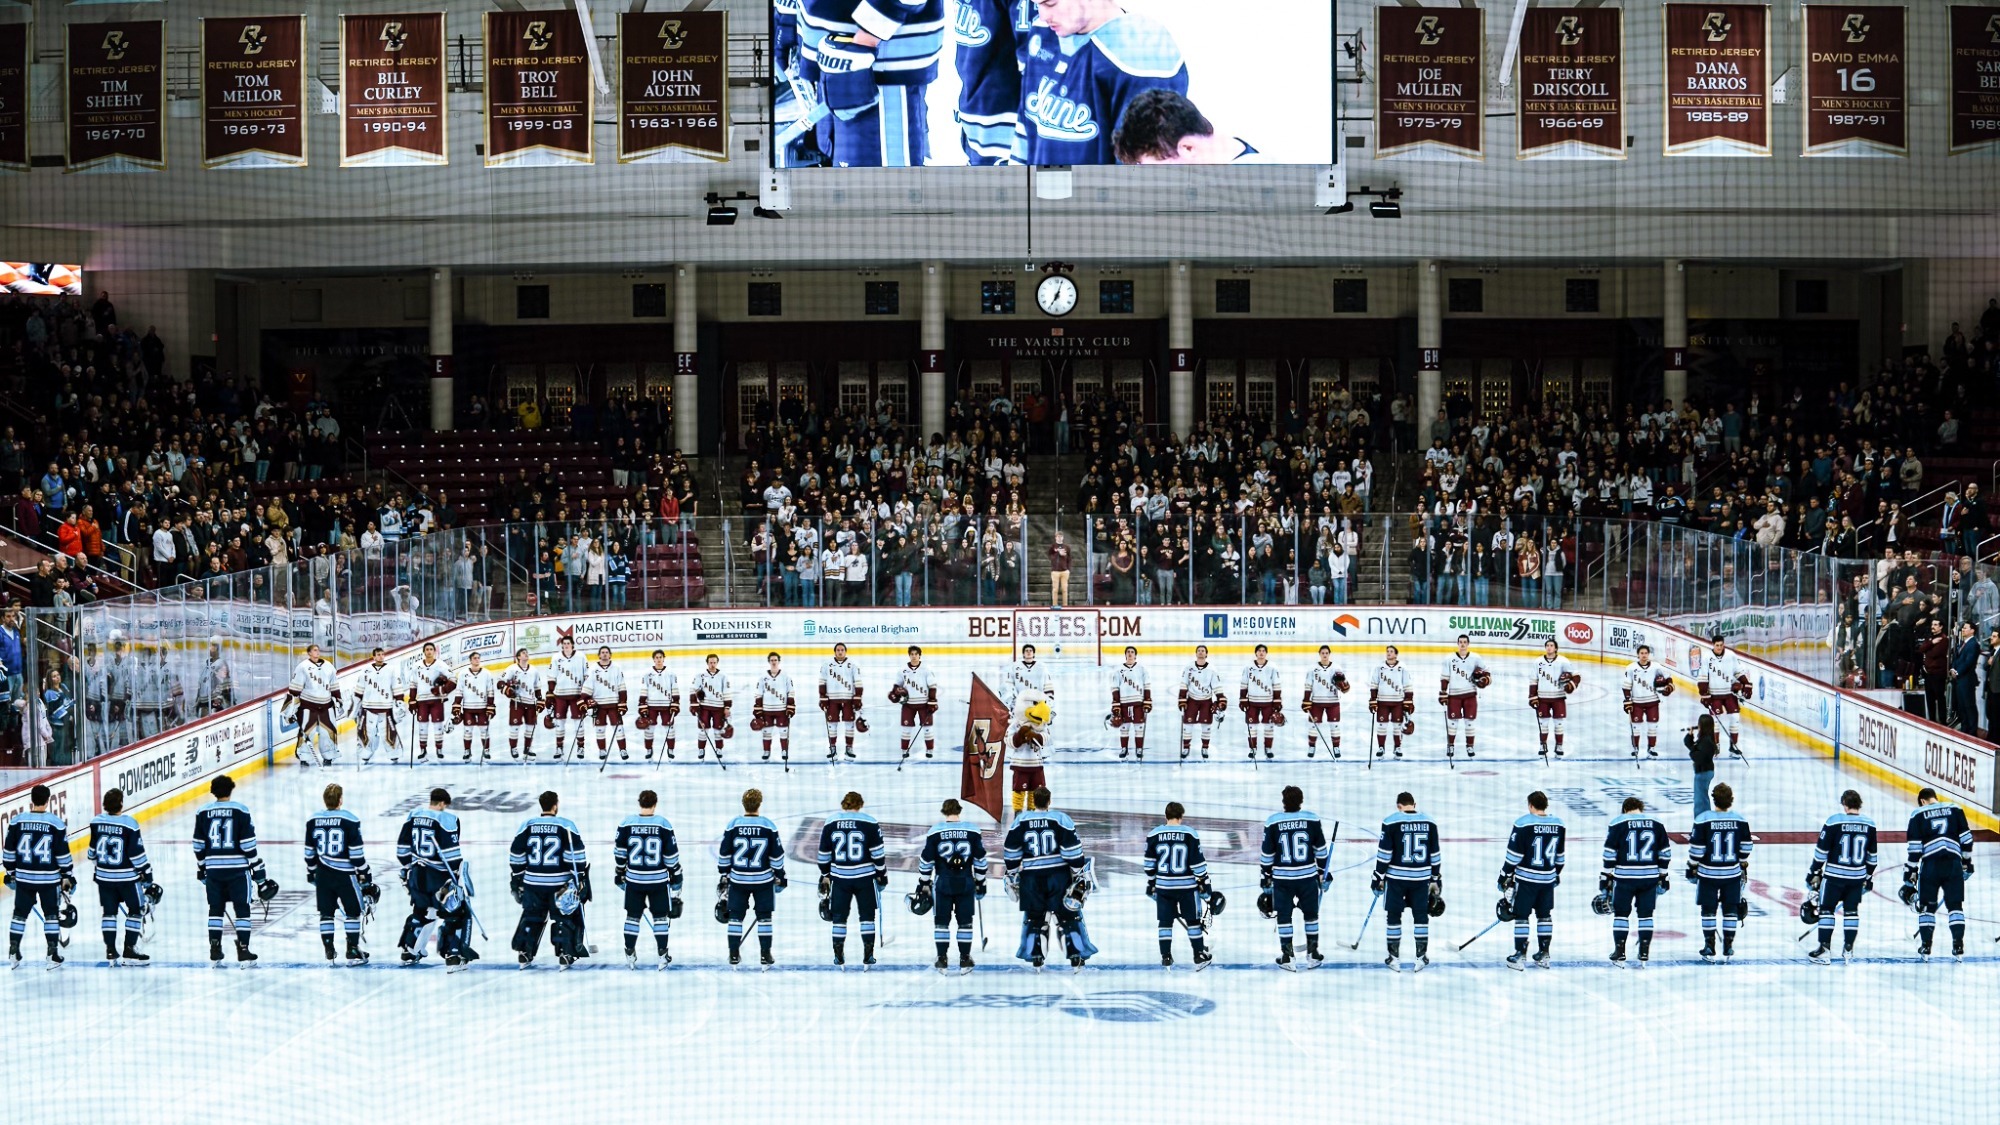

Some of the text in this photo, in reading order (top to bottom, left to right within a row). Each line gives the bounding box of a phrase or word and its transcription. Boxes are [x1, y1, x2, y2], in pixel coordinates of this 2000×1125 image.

[1524, 54, 1616, 63] RETIRED JERSEY
[1671, 48, 1762, 56] RETIRED JERSEY
[1812, 52, 1899, 64] DAVID EMMA
[209, 60, 296, 69] RETIRED JERSEY
[350, 57, 438, 67] RETIRED JERSEY
[493, 55, 583, 66] RETIRED JERSEY
[626, 55, 718, 64] RETIRED JERSEY
[1383, 54, 1476, 64] RETIRED JERSEY
[73, 64, 157, 75] RETIRED JERSEY
[1418, 68, 1442, 82] JOE
[1547, 68, 1593, 80] TERRY
[1695, 62, 1740, 75] DANA
[235, 74, 269, 87] TOM
[377, 72, 409, 85] BILL
[518, 70, 559, 83] TROY
[652, 69, 693, 85] JOHN
[1836, 68, 1876, 92] 16
[101, 80, 128, 93] TIM
[1397, 83, 1462, 97] MULLEN
[1533, 83, 1609, 96] DRISCOLL
[1687, 77, 1748, 90] BARROS
[223, 89, 283, 103] MELLOR
[364, 87, 422, 100] CURLEY
[521, 85, 557, 99] BELL
[644, 84, 701, 97] AUSTIN
[86, 94, 144, 108] SHEEHY
[1393, 102, 1466, 112] MEN'S HOCKEY
[1525, 102, 1618, 111] MEN'S BASKETBALL
[1672, 96, 1763, 106] MEN'S BASKETBALL
[1821, 99, 1891, 110] MEN'S HOCKEY
[224, 109, 283, 118] MEN'S HOCKEY
[356, 106, 432, 115] MEN'S BASKETBALL
[500, 105, 577, 114] MEN'S BASKETBALL
[661, 104, 711, 112] BASKETBALL
[112, 114, 143, 122] HOCKEY
[630, 118, 718, 128] 1963-1966
[1398, 117, 1462, 129] 1975-79
[1539, 117, 1604, 129] 1966-69
[1686, 111, 1749, 123] 1985-89
[1827, 114, 1886, 126] 1987-91
[223, 124, 286, 135] 1969-73
[364, 121, 427, 133] 1990-94
[508, 119, 572, 131] 1999-03
[86, 128, 145, 140] 1967-70
[988, 337, 1131, 347] THE VARSITY CLUB
[930, 354, 937, 368] F
[1178, 353, 1185, 367] G
[1675, 352, 1682, 366] H
[436, 359, 442, 373] E
[575, 619, 663, 633] MARTIGNETTI
[692, 616, 772, 631] RODENHISER
[968, 616, 1142, 637] BCEAGLES.COM
[1208, 616, 1224, 635] M
[1449, 616, 1556, 633] SULLIVAN TIRE
[819, 624, 919, 637] Mass General Brigham
[1527, 632, 1556, 641] SERVICE
[1567, 627, 1591, 640] Hood
[1612, 627, 1628, 638] BUD
[576, 632, 663, 645] CONSTRUCTION
[1609, 636, 1631, 649] LIGHT
[1858, 713, 1898, 760] BOSTON
[1924, 739, 1976, 794] COLLEGE
[118, 752, 177, 797] POWERADE
[207, 809, 232, 818] LIPINSKI
[1923, 808, 1952, 819] LANGLOIS
[631, 826, 659, 835] PICHETTE
[836, 821, 857, 829] FREEL
[1029, 820, 1049, 829] BOIJA
[1278, 820, 1307, 831] USEREAU
[1400, 823, 1430, 832] CHABRIER
[1533, 825, 1559, 834] SCHOLLE
[1627, 820, 1653, 829] FOWLER
[1710, 821, 1738, 830] RUSSELL
[1841, 824, 1868, 833] COUGHLIN
[1930, 818, 1948, 835] 7
[208, 818, 235, 849] 41
[738, 827, 761, 836] SCOTT
[940, 831, 968, 840] GERRIOR
[1158, 833, 1185, 842] NADEAU
[17, 833, 53, 864] 44
[312, 828, 344, 856] 38
[831, 831, 864, 862] 26
[1023, 830, 1056, 857] 30
[1278, 831, 1310, 863] 16
[1401, 832, 1428, 863] 15
[1625, 830, 1654, 862] 12
[1710, 831, 1736, 862] 11
[96, 835, 123, 865] 43
[527, 836, 561, 866] 32
[628, 836, 662, 866] 29
[733, 837, 768, 868] 27
[1531, 835, 1559, 867] 14
[1838, 834, 1867, 865] 10
[1156, 843, 1188, 874] 20
